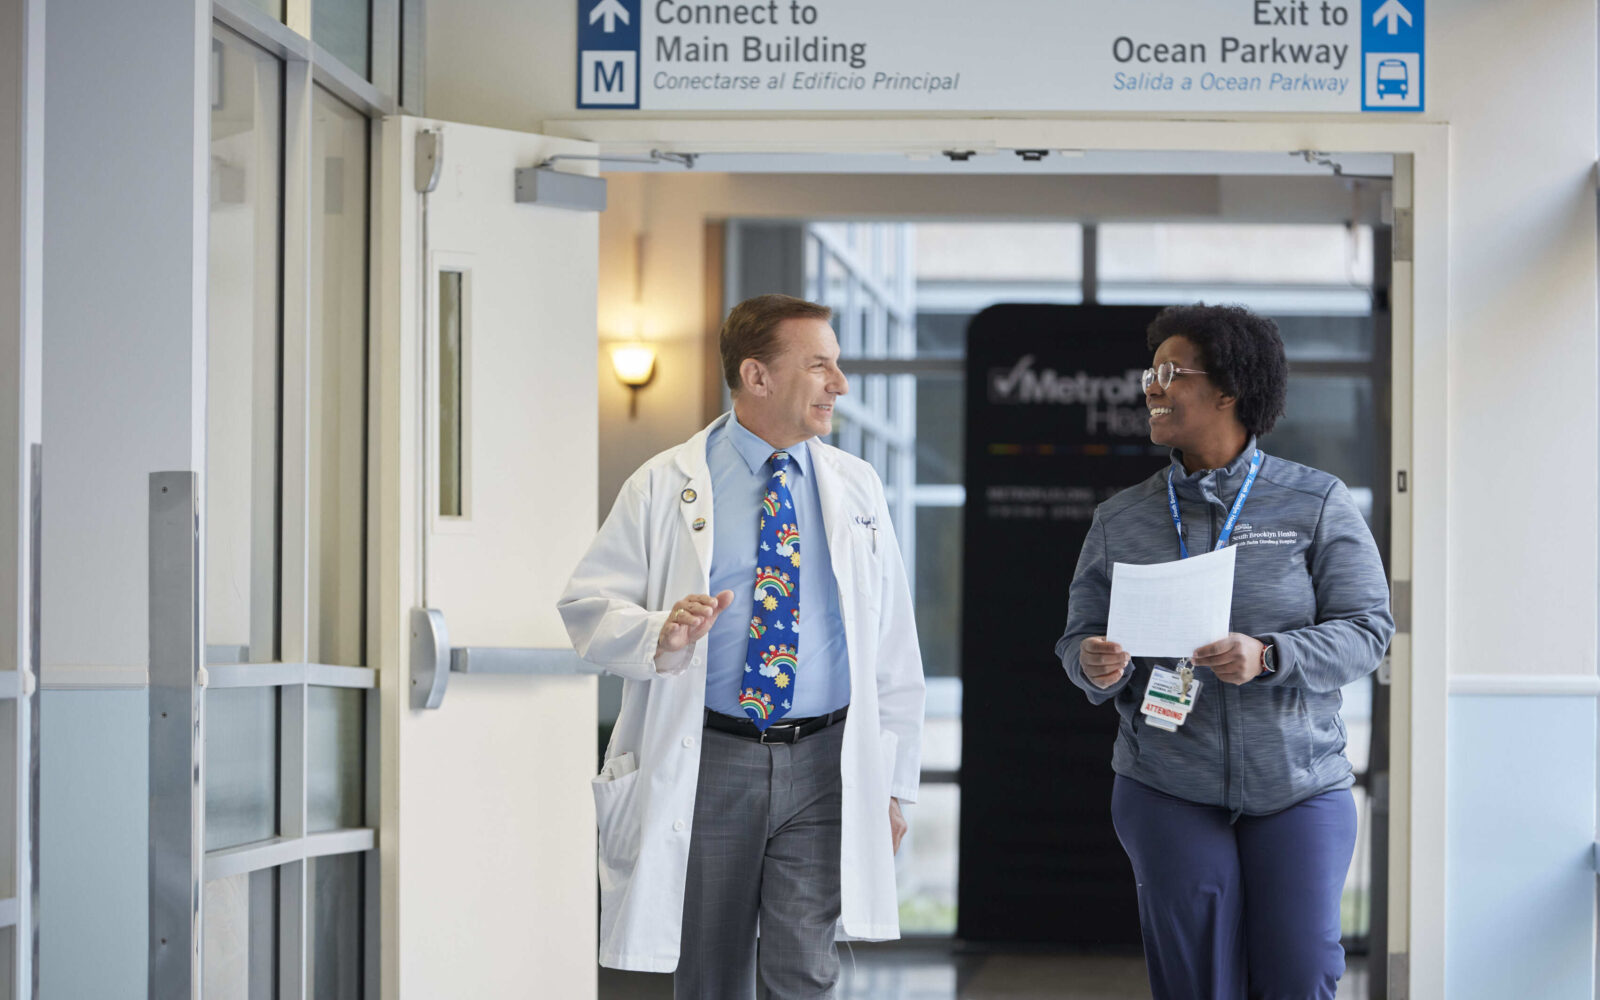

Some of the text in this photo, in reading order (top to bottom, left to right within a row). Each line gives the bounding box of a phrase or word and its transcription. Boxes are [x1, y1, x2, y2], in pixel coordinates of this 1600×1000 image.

[655, 0, 817, 25] Connect to
[1254, 0, 1348, 26] Exit to
[655, 36, 866, 69] Main Building
[1112, 36, 1349, 70] Ocean Parkway
[594, 60, 624, 92] M
[653, 71, 961, 93] Conectarse al Edificio Principal
[1113, 71, 1349, 96] Salida a Ocean Parkway
[1249, 531, 1277, 539] Brooklyn
[1278, 530, 1298, 538] Health
[1145, 704, 1182, 720] ATTENDING
